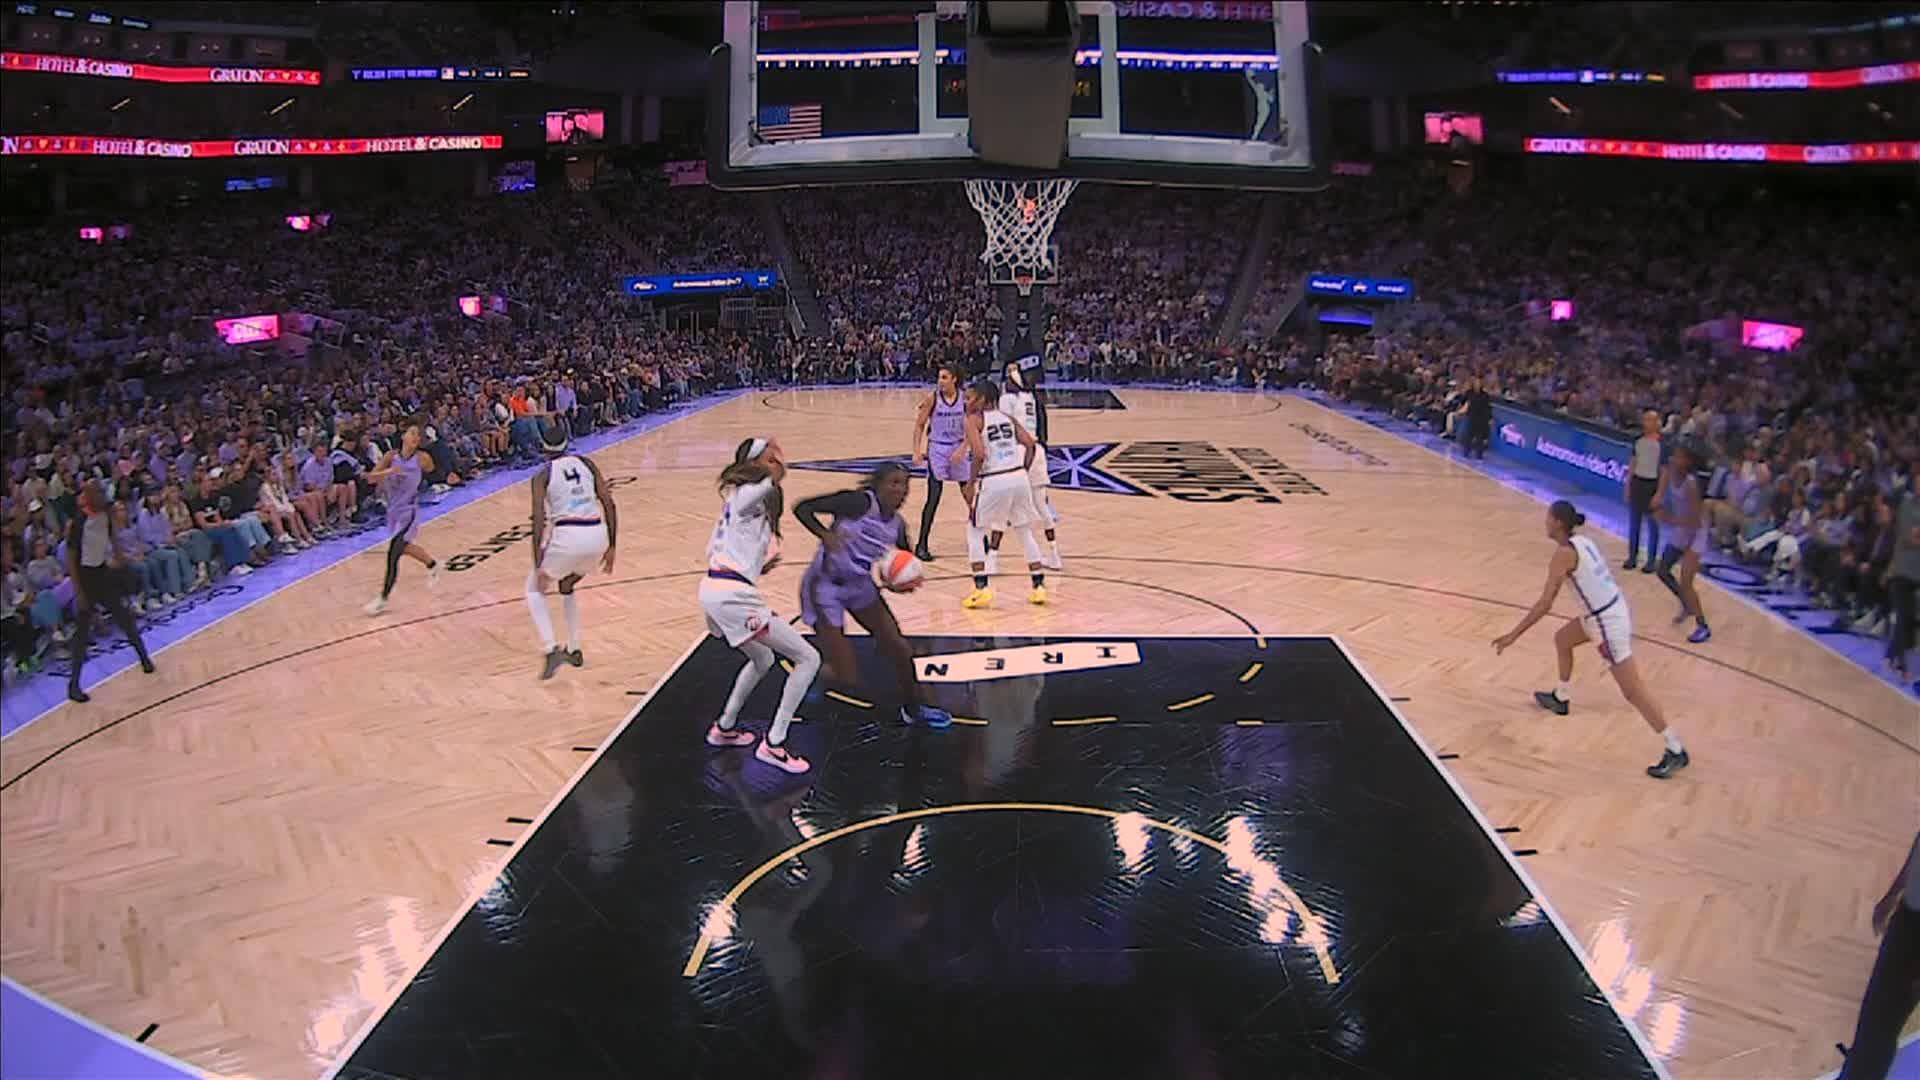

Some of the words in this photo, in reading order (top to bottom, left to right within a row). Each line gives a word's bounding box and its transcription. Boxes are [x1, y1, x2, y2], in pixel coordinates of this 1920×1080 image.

[210, 67, 264, 82] GRATON
[234, 139, 290, 154] GRATON
[429, 136, 482, 150] CASINO
[987, 423, 1014, 441] 25
[563, 467, 581, 485] 4
[923, 645, 1118, 677] IREN
